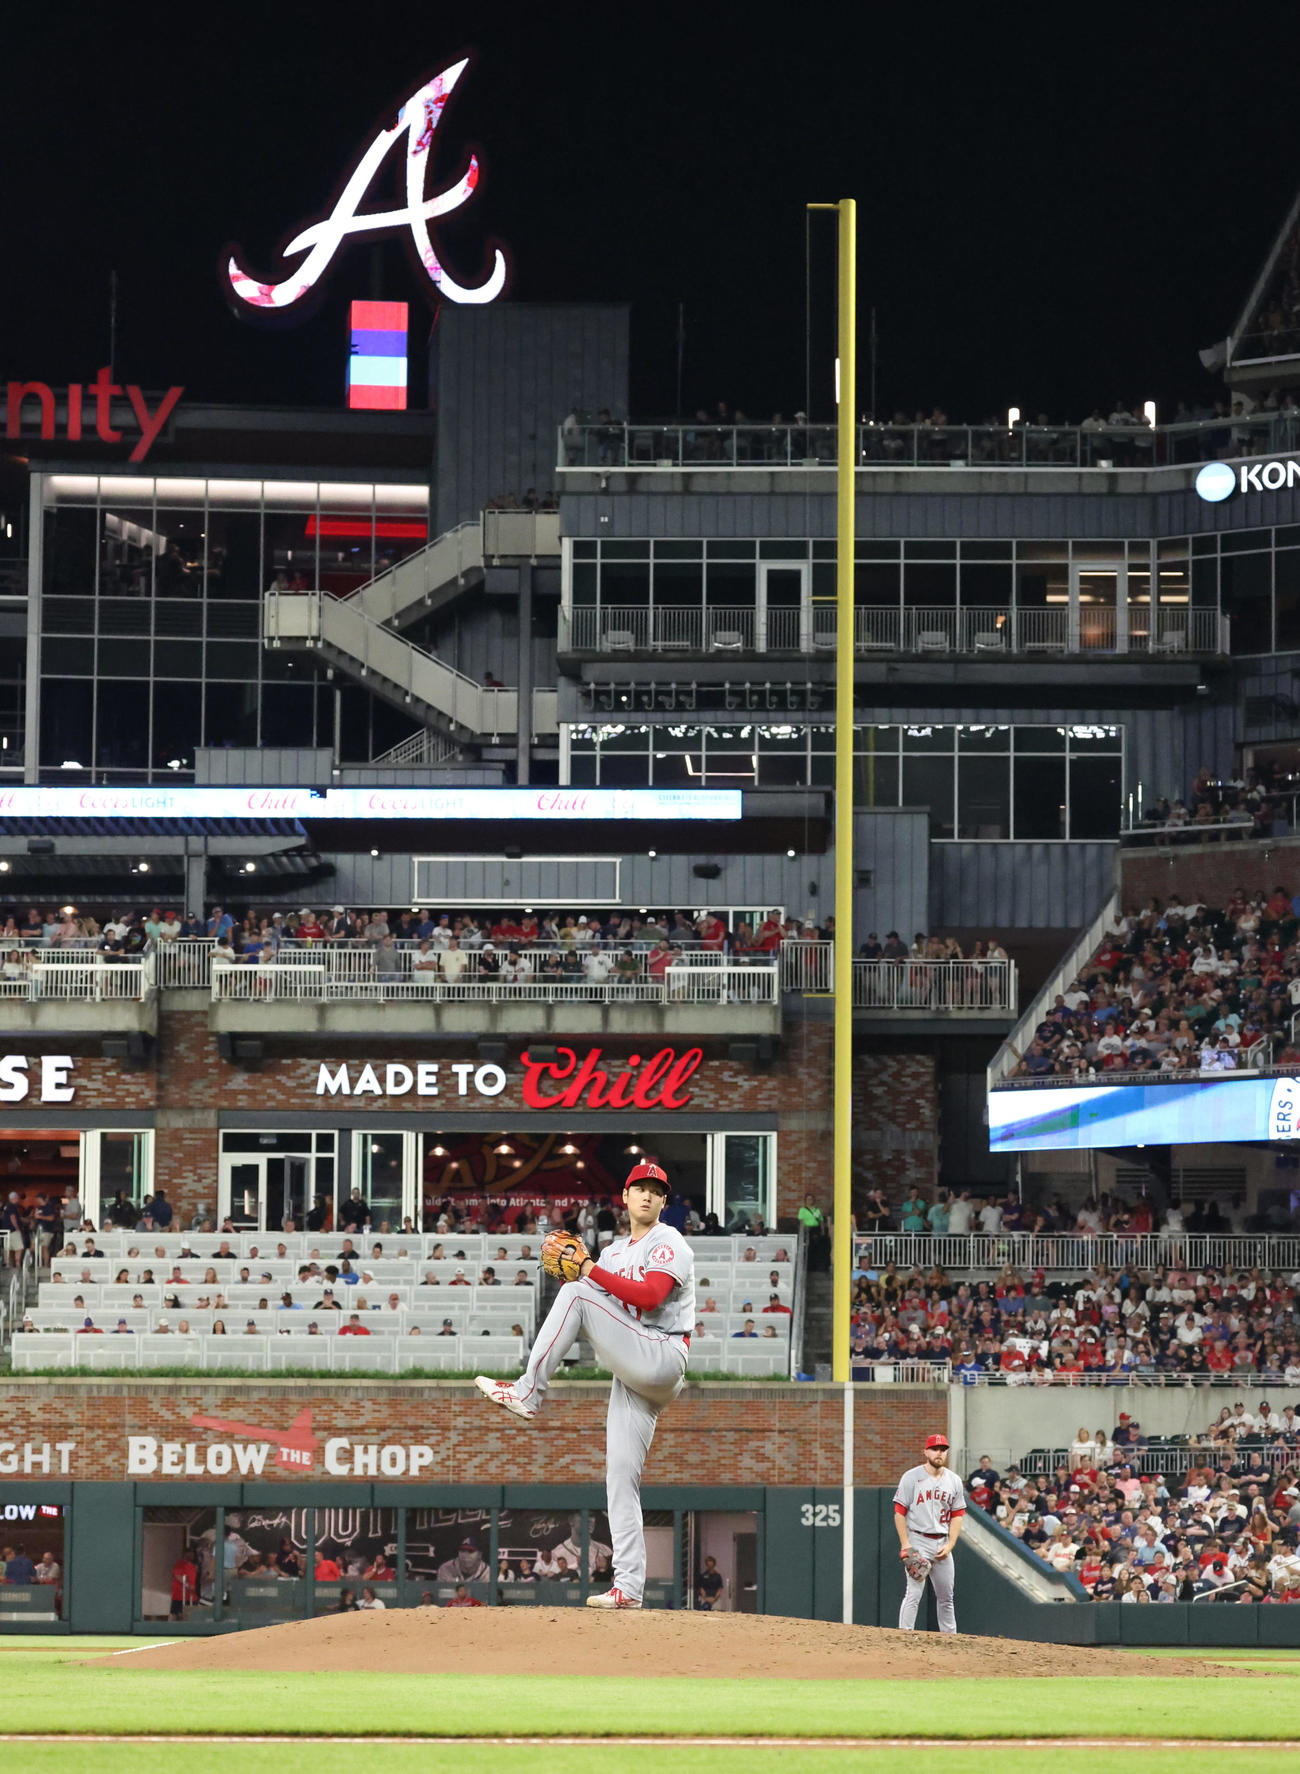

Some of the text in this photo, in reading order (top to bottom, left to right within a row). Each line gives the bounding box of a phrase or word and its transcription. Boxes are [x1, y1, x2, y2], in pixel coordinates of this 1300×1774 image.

[6, 365, 184, 462] nity
[247, 792, 297, 810] Chill
[537, 793, 588, 811] Chill
[315, 1047, 703, 1109] MADE TO Chill
[1276, 1100, 1294, 1138] ERS
[647, 1164, 659, 1177] A
[0, 1442, 76, 1474] GHT
[127, 1436, 434, 1476] BELOW THE CHOP
[41, 1505, 59, 1516] THE
[800, 1503, 841, 1527] 325
